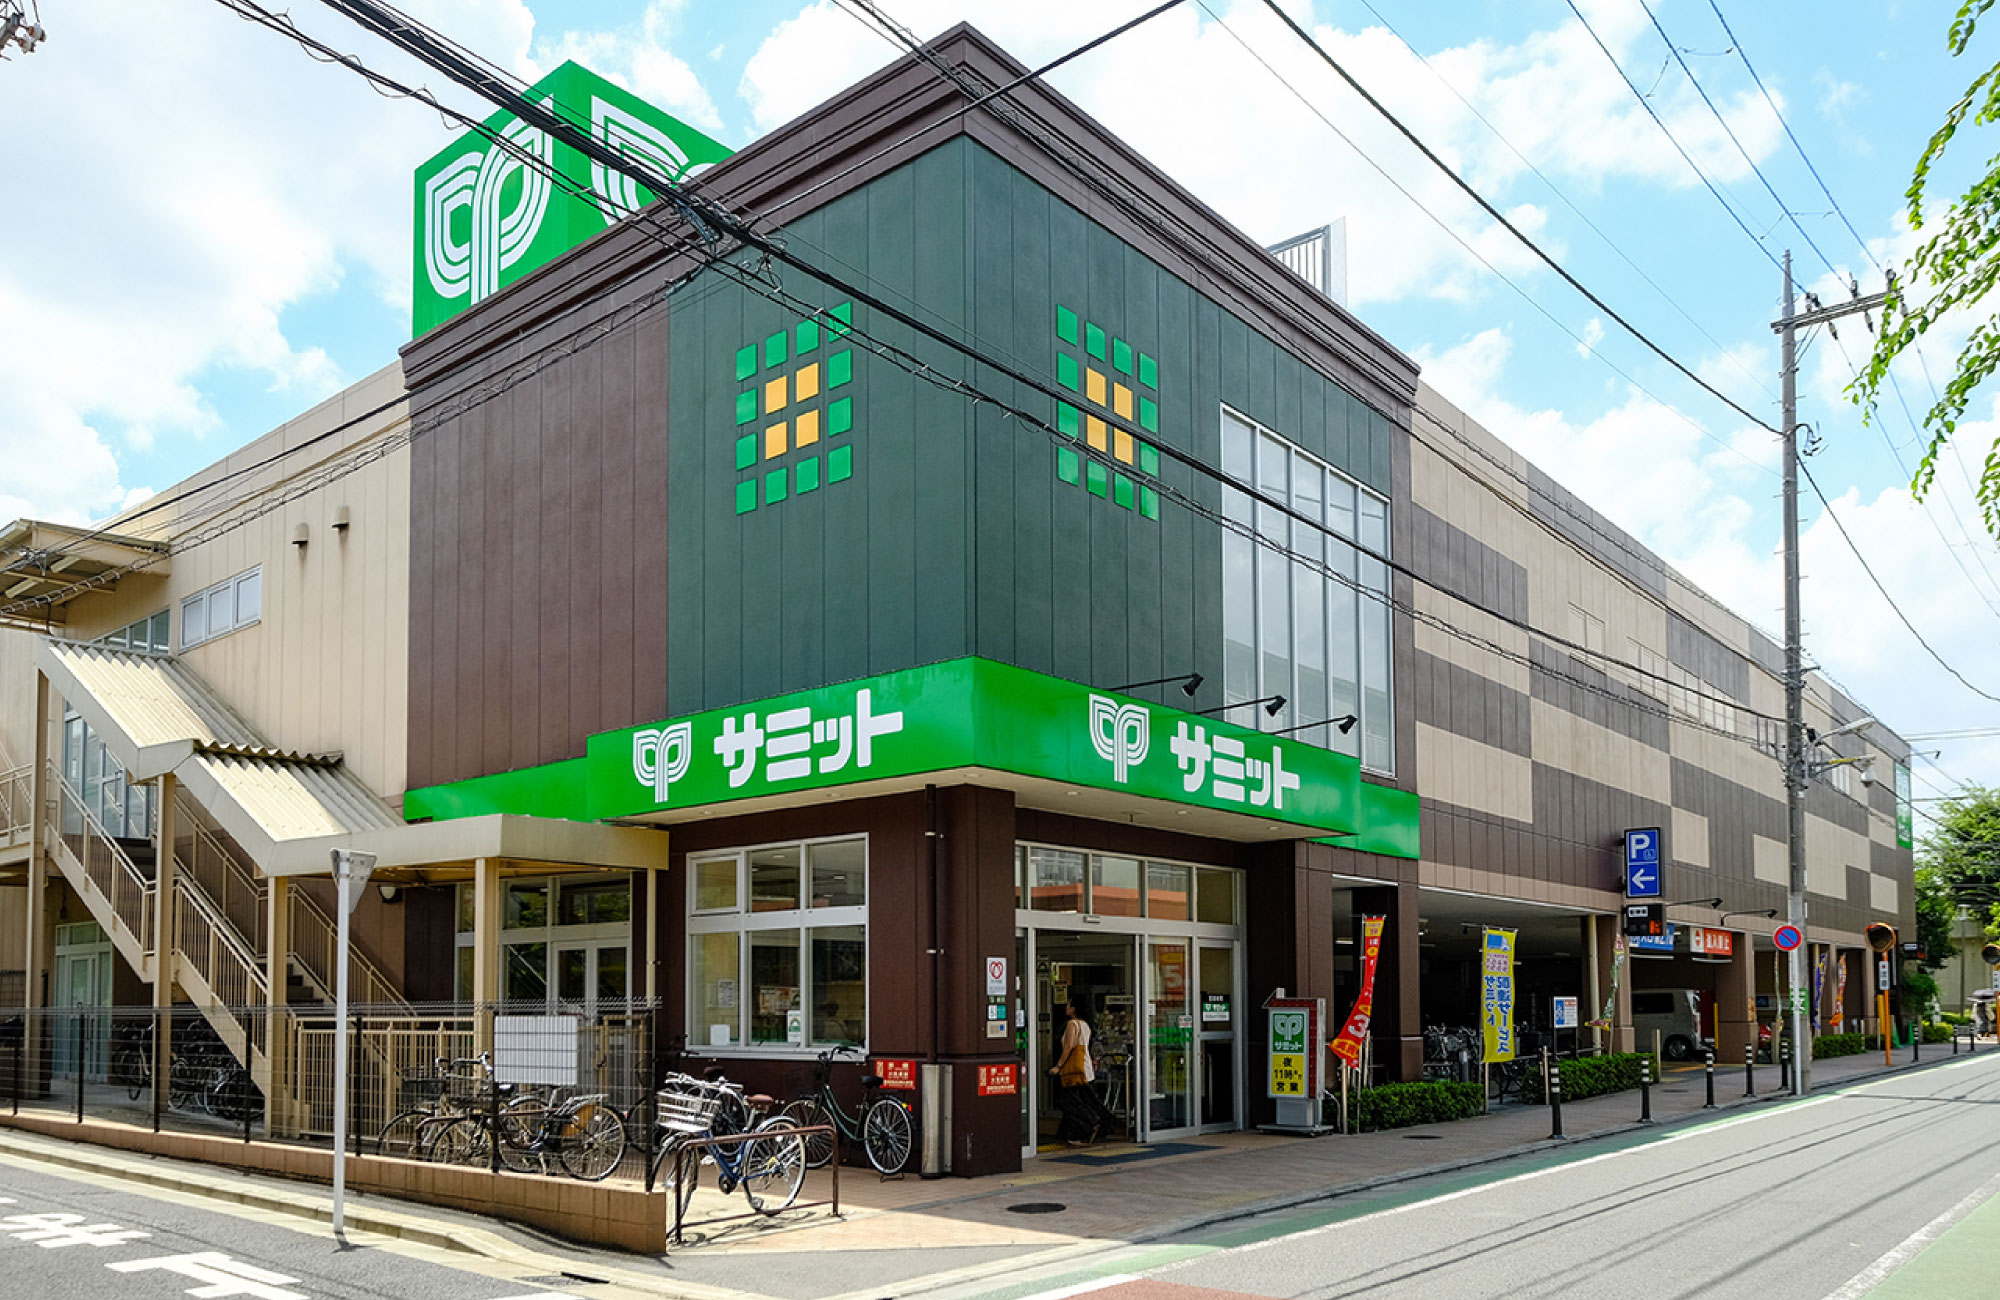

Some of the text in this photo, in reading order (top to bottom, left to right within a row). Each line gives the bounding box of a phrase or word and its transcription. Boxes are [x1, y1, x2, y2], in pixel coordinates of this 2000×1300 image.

[713, 688, 904, 788] サミット
[1169, 720, 1301, 810] サミット
[1630, 834, 1650, 859] P
[1274, 1041, 1302, 1051] サミット
